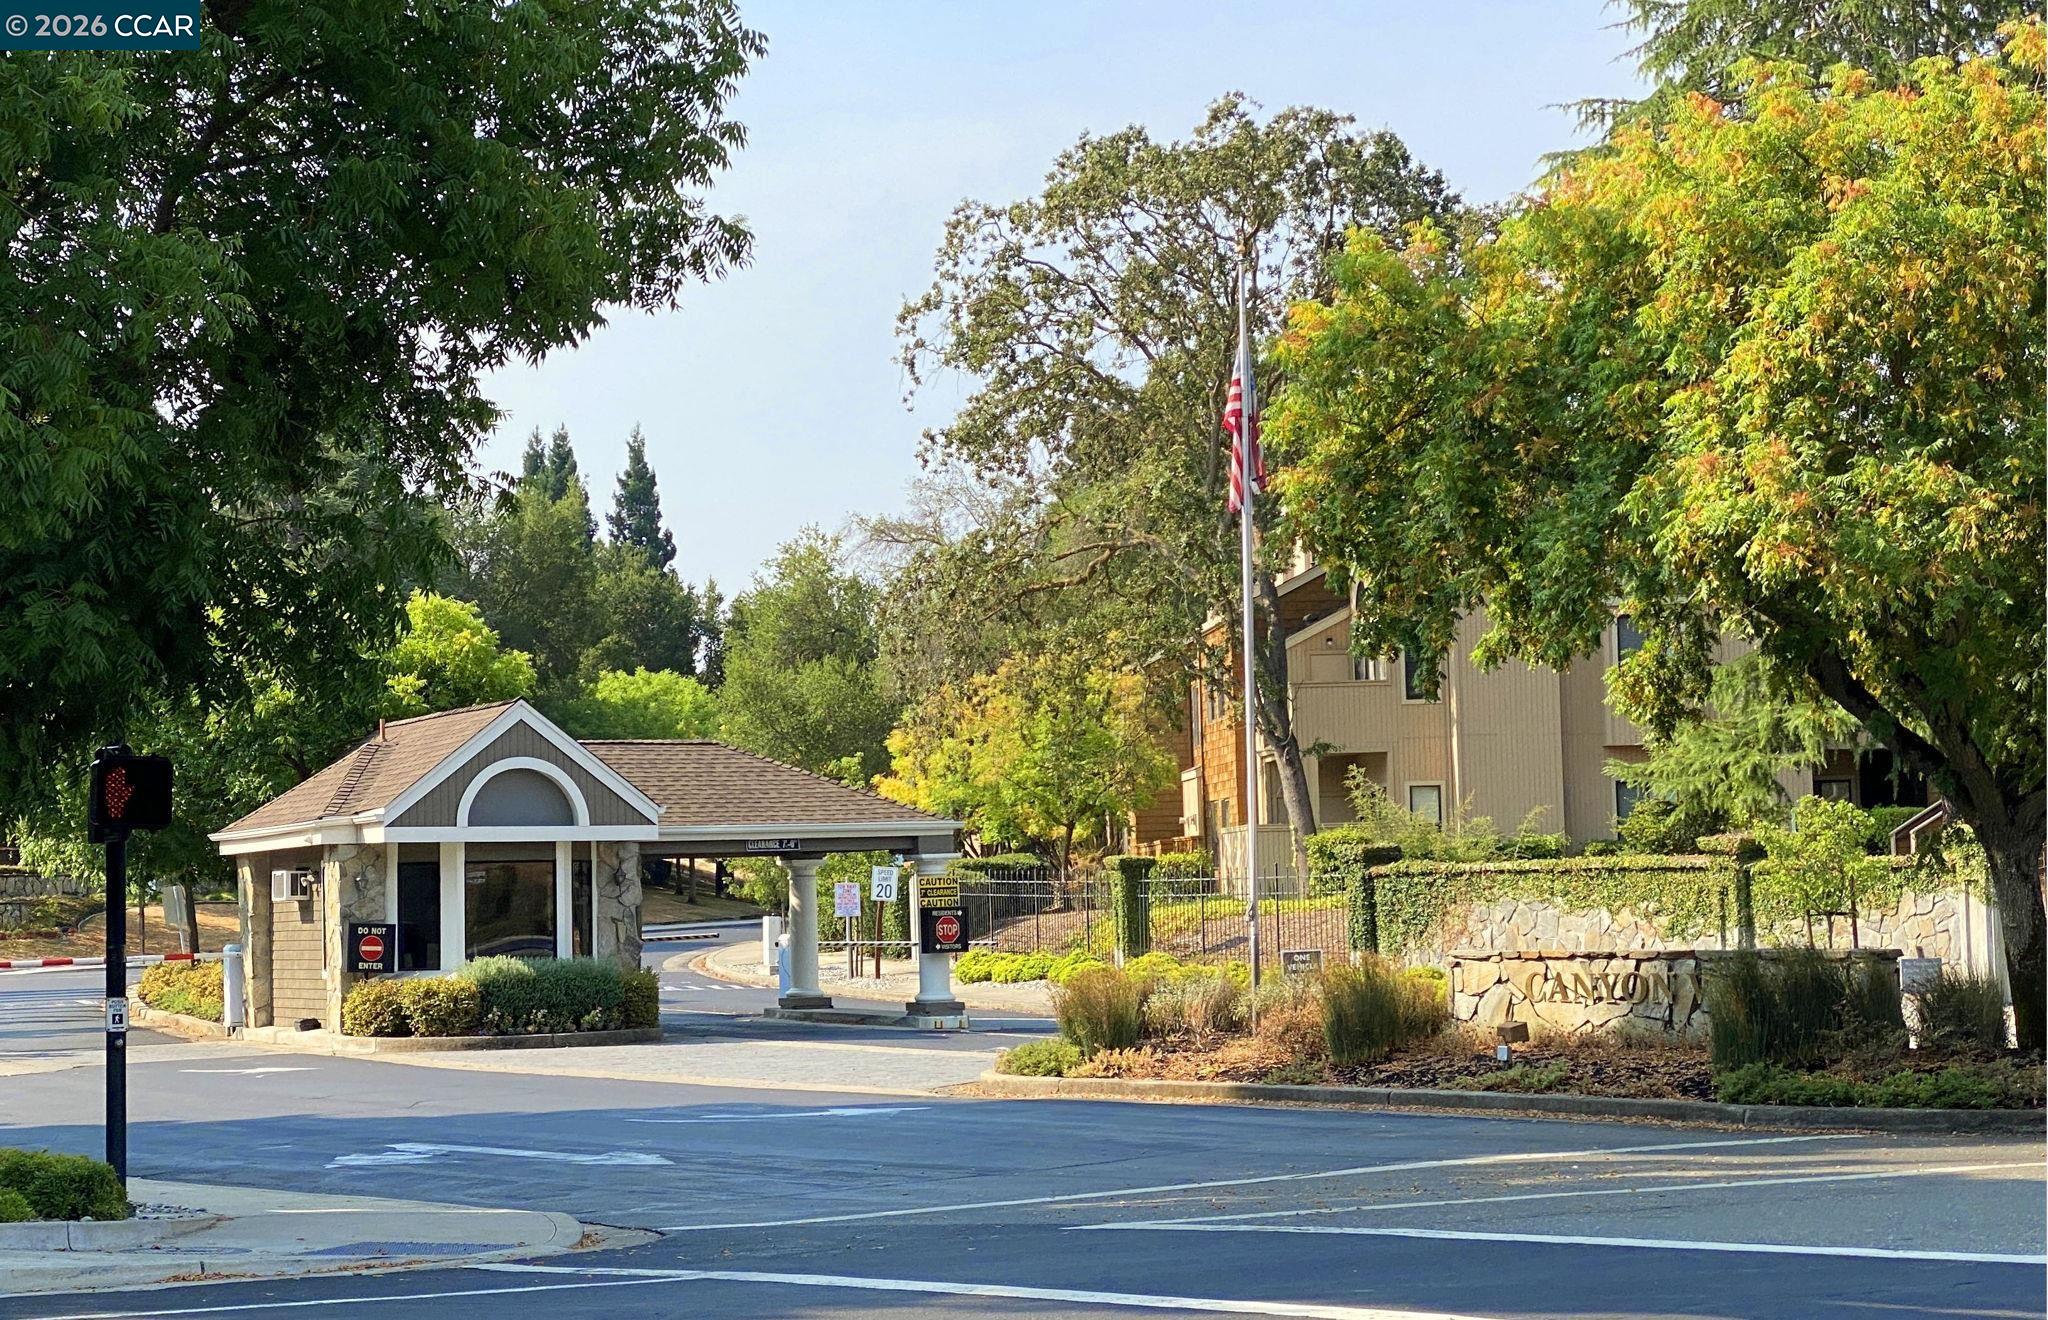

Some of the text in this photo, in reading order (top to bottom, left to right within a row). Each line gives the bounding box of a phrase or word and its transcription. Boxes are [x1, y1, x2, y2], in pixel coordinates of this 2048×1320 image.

[748, 839, 780, 849] CLEARANCE
[919, 877, 958, 887] CAUTION
[876, 883, 892, 899] 20
[927, 888, 957, 897] CLEARANCE
[920, 898, 959, 907] CAUTION
[371, 927, 387, 935] NOT
[938, 924, 958, 936] STOP
[1293, 953, 1311, 962] ONE
[358, 962, 383, 970] ENTER
[1525, 971, 1674, 1005] CANYON
